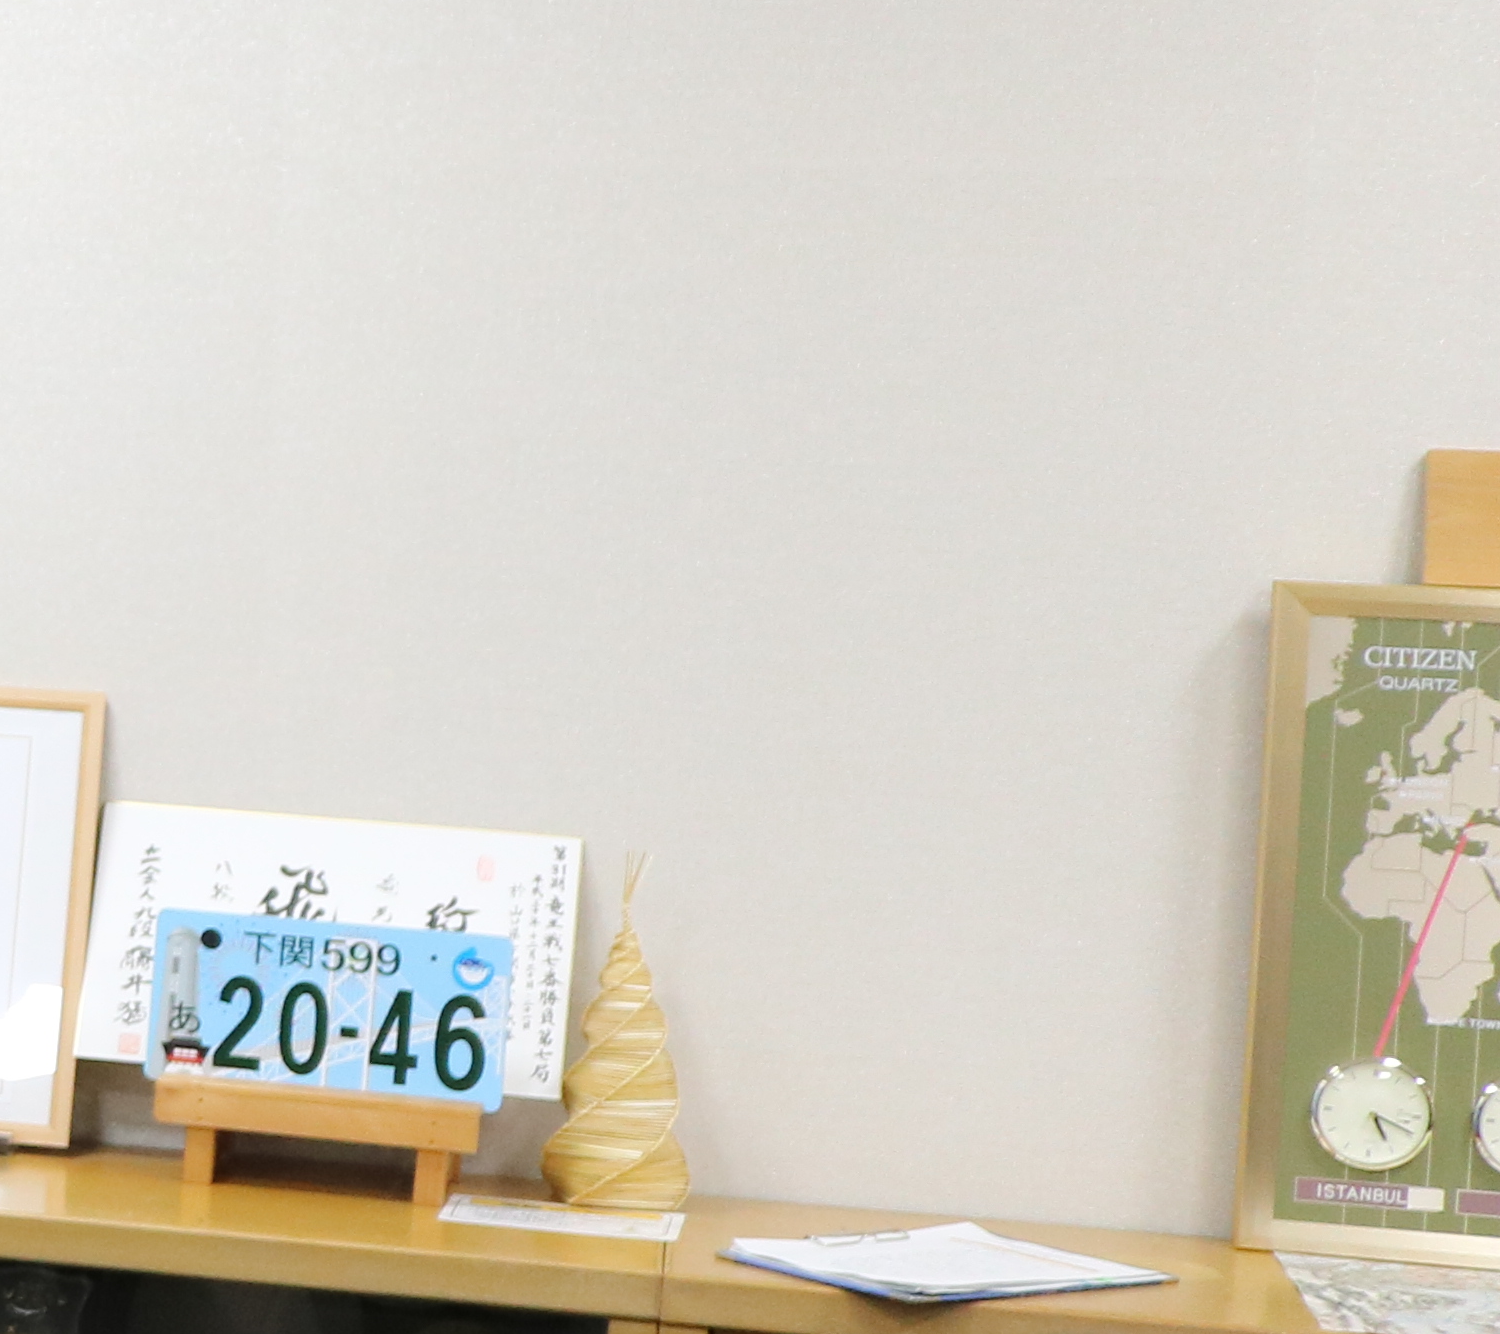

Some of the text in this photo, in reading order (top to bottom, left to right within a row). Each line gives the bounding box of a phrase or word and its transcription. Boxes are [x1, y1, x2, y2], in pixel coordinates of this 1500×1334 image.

[1363, 645, 1478, 671] CITIZEN
[1380, 675, 1460, 692] QUARTZ
[169, 975, 486, 1091] あ 20-46
[1316, 1182, 1409, 1205] ISTANBUL
